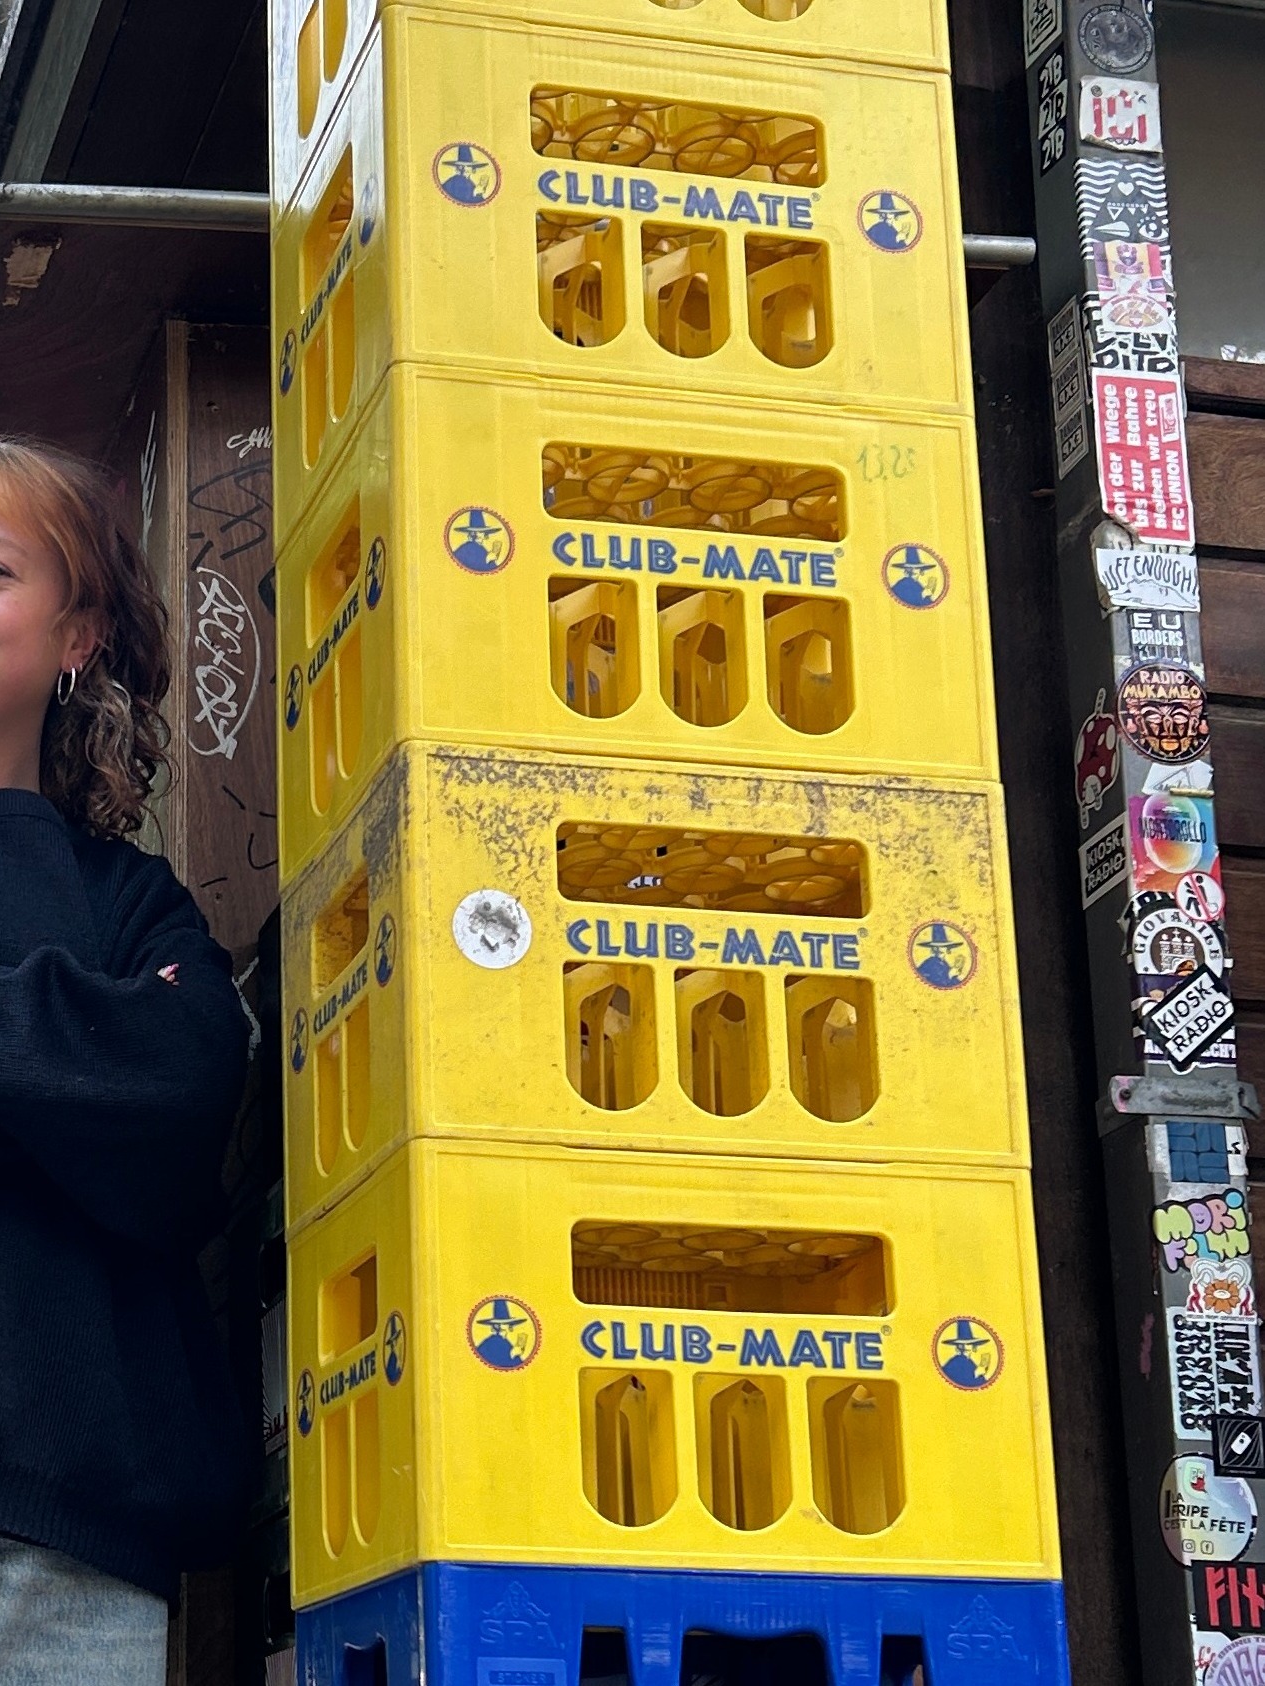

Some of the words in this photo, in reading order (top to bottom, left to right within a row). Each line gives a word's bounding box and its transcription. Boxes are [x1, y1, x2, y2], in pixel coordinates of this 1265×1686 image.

[537, 169, 814, 230] CLUB-MATE
[301, 234, 352, 344] CLUB-MATE
[1104, 383, 1121, 444] Wiege
[1124, 386, 1142, 447] Bahre
[1144, 388, 1158, 427] treu
[1109, 452, 1124, 487] der
[1146, 433, 1160, 461] wir
[1130, 459, 1145, 492] zur
[1151, 468, 1167, 529] bleiben
[1166, 450, 1184, 504] UNION
[1133, 498, 1149, 528] bis
[1171, 507, 1186, 531] FC
[552, 531, 837, 588] CLUB-MATE
[308, 586, 360, 686] CLUB-MATE
[1131, 629, 1184, 646] BORDERS
[1132, 612, 1183, 630] EU
[1123, 684, 1202, 700] MUKAMBO
[1140, 670, 1184, 685] RADIO
[1086, 826, 1123, 870] KIOSK
[1086, 852, 1126, 892] RADIO
[566, 918, 860, 970] CLUB-MATE
[313, 956, 368, 1035] CLUB-MATE
[1157, 980, 1213, 1034] KIOSK
[1172, 999, 1228, 1053] RADIO
[581, 1320, 884, 1370] CLUB-MATE
[319, 1349, 377, 1406] CLUB-MATE
[1171, 1504, 1210, 1519] FRIPE
[1189, 1519, 1206, 1531] LA
[1209, 1515, 1247, 1534] FÊTE
